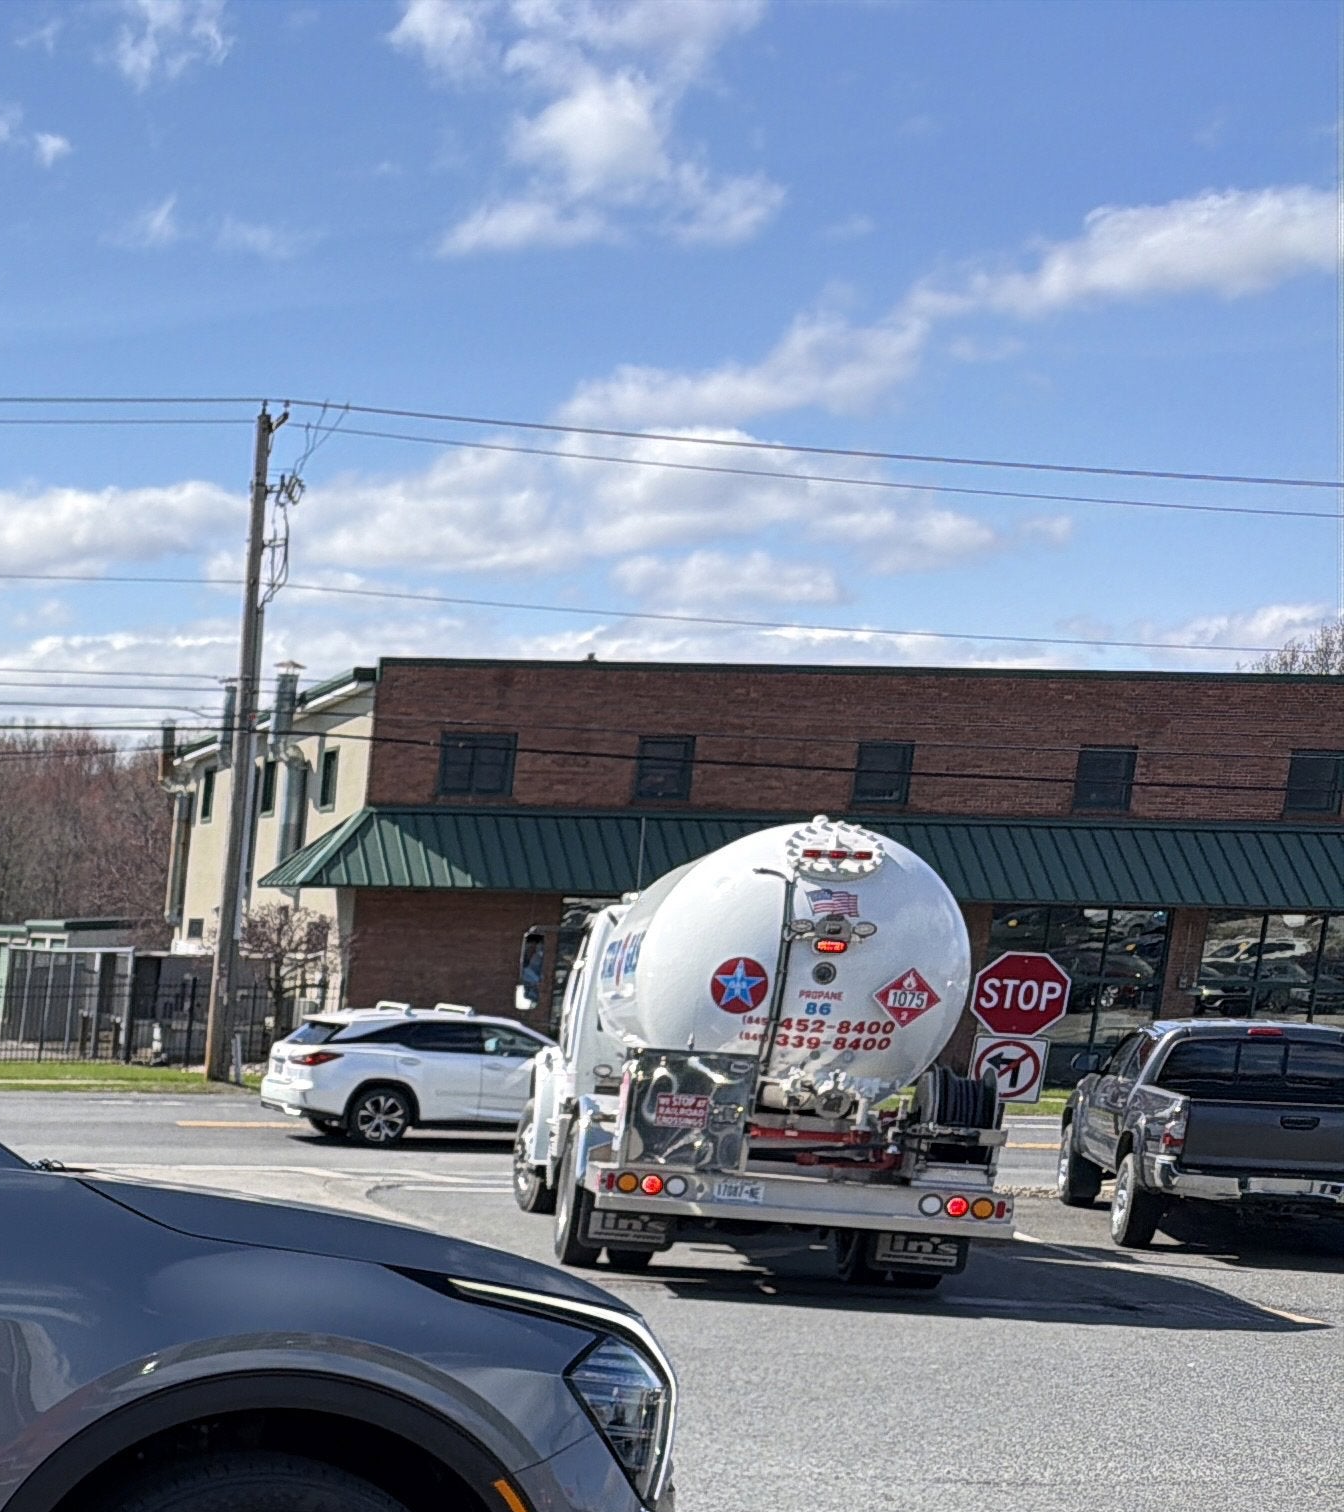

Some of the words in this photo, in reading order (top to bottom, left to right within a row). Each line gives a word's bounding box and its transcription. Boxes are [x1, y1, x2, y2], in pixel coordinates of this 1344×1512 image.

[799, 989, 844, 1001] PROPANE
[891, 990, 925, 1008] 1075
[979, 977, 1062, 1012] STOP
[805, 1002, 832, 1016] 86
[900, 1011, 909, 1021] 2
[778, 1017, 896, 1035] 452-8400
[775, 1033, 892, 1051] 339-8400
[672, 1095, 696, 1106] STOP
[658, 1106, 705, 1117] RAILROAD
